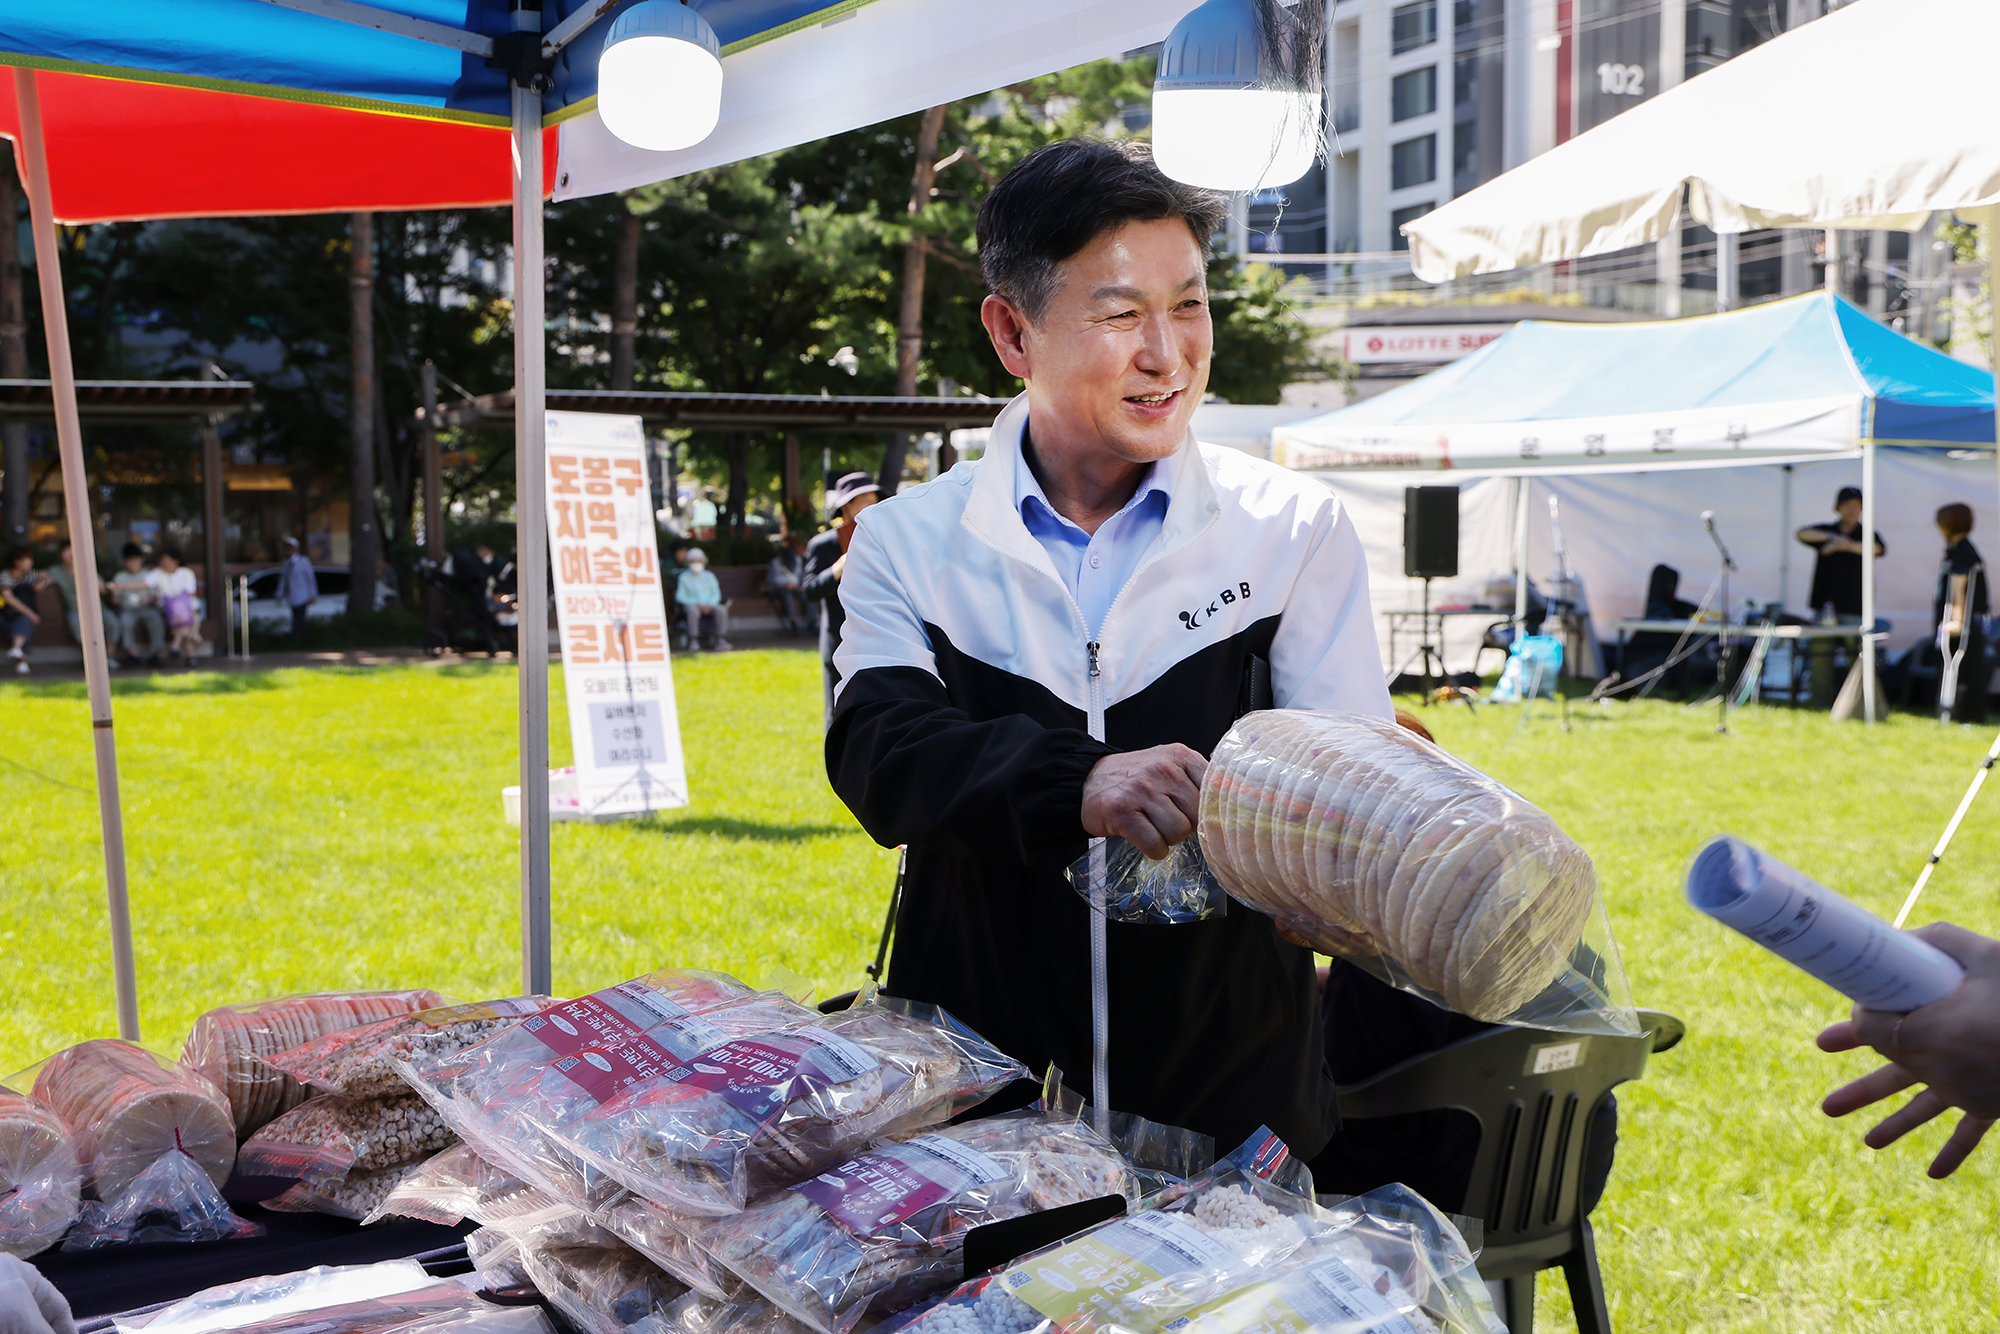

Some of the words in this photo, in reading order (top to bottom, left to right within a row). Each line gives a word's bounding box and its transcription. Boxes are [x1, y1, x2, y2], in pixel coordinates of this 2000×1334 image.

[1597, 62, 1645, 96] 102
[1387, 335, 1452, 351] LOTTE
[549, 455, 644, 497] 도봉구
[554, 500, 618, 540] 지역
[560, 545, 655, 585] 예술인
[564, 595, 629, 616] 찾아가는
[1205, 581, 1251, 618] KBB
[567, 623, 665, 664] 콘서트
[583, 676, 621, 694] 오늘의
[562, 1002, 591, 1021] 간식
[708, 1047, 789, 1080] 현미고구마
